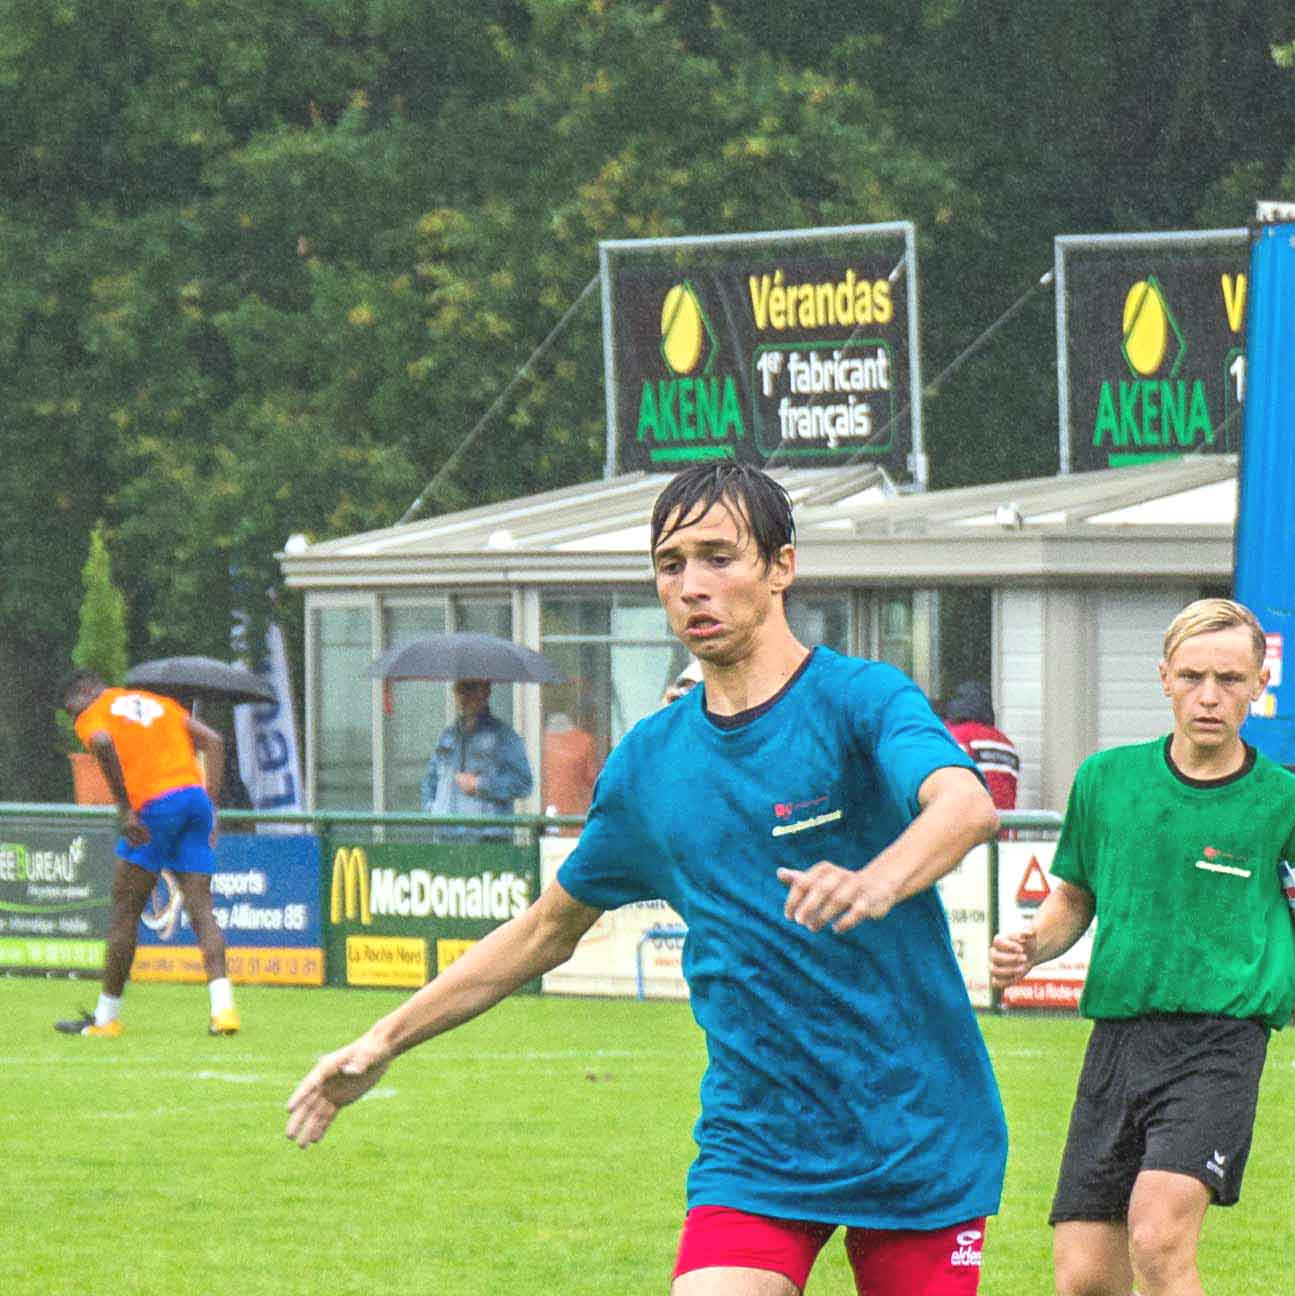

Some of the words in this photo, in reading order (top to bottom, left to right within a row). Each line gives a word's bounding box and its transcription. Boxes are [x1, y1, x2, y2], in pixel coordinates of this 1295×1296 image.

[749, 268, 894, 330] Vérandas
[787, 347, 891, 394] fabricant
[636, 376, 745, 441] AKENA
[778, 395, 871, 449] français
[1093, 379, 1215, 446] AKENA
[210, 868, 267, 898] nsports
[370, 867, 530, 919] McDonald's
[228, 903, 283, 930] Alliance
[283, 902, 308, 931] 85
